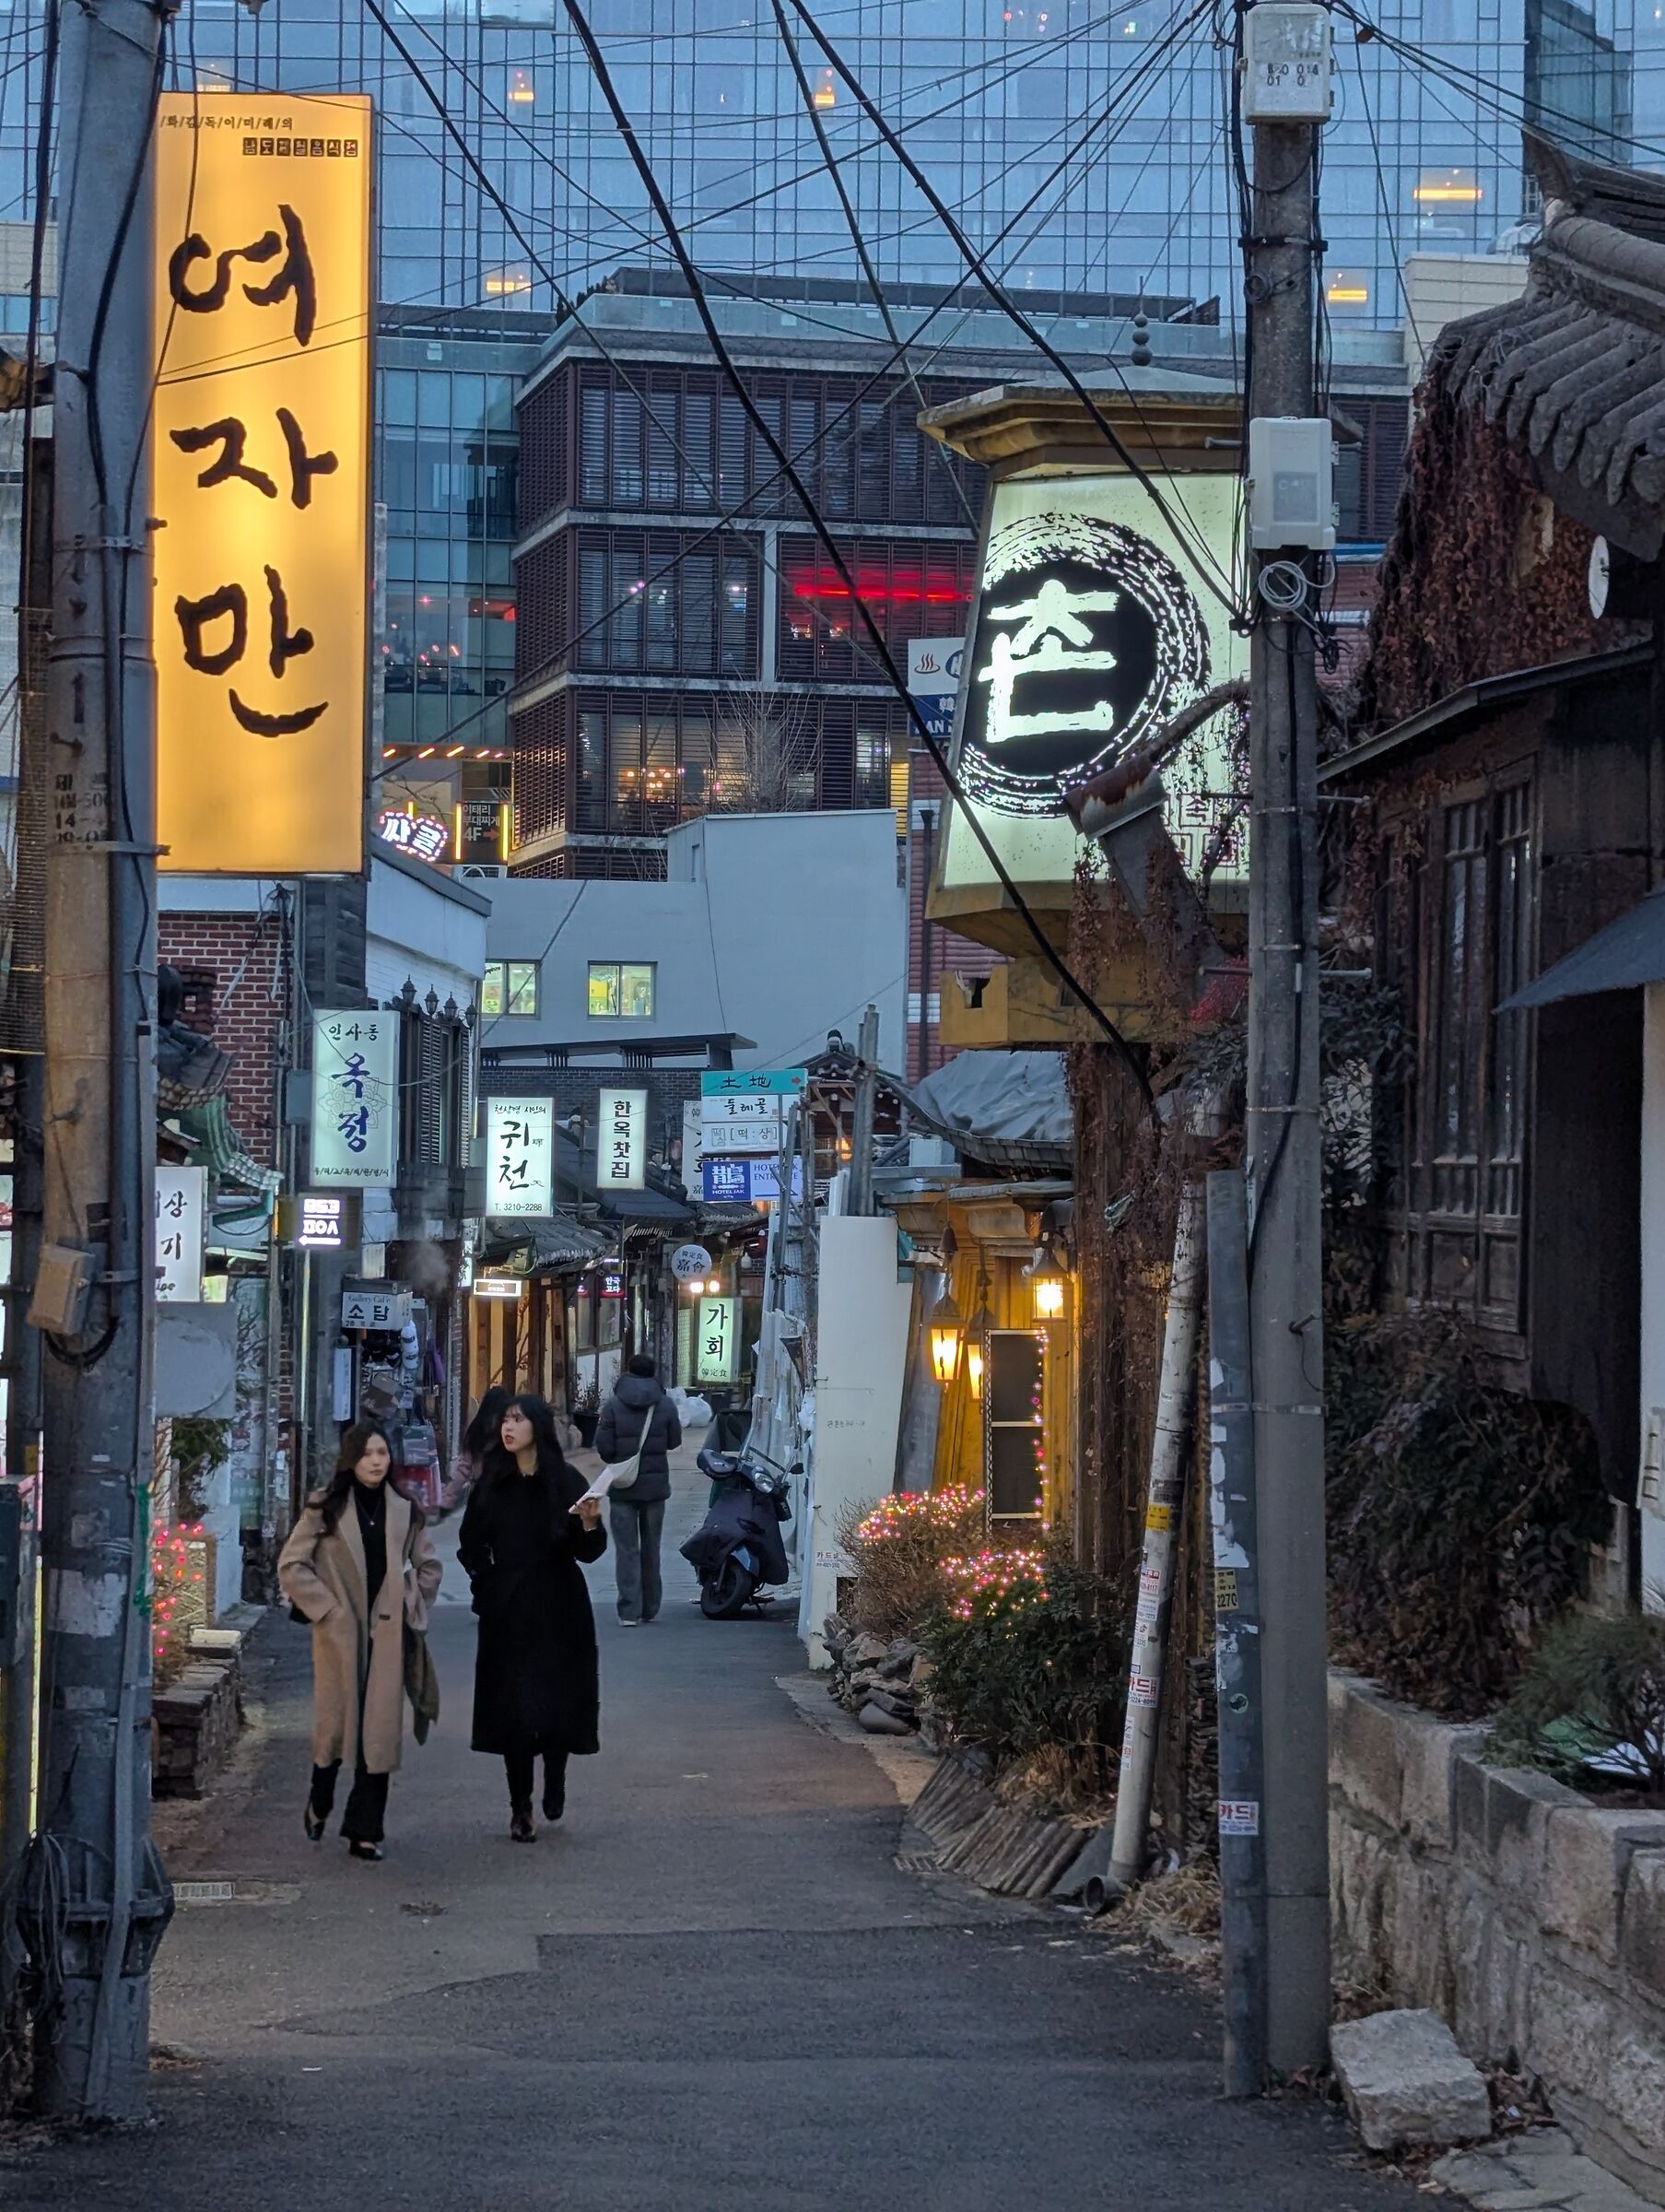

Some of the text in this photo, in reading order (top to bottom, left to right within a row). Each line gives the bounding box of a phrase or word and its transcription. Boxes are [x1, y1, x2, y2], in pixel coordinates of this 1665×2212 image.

[169, 204, 338, 737] 여자만
[464, 828, 483, 841] 4F
[329, 1023, 379, 1041] 인사동
[332, 1053, 370, 1152] 옥정
[721, 1074, 771, 1088] 土地
[499, 1121, 530, 1190] 귀천
[612, 1100, 631, 1179] 한옥찻집
[347, 1304, 389, 1322] 소담
[706, 1303, 728, 1362] 가회
